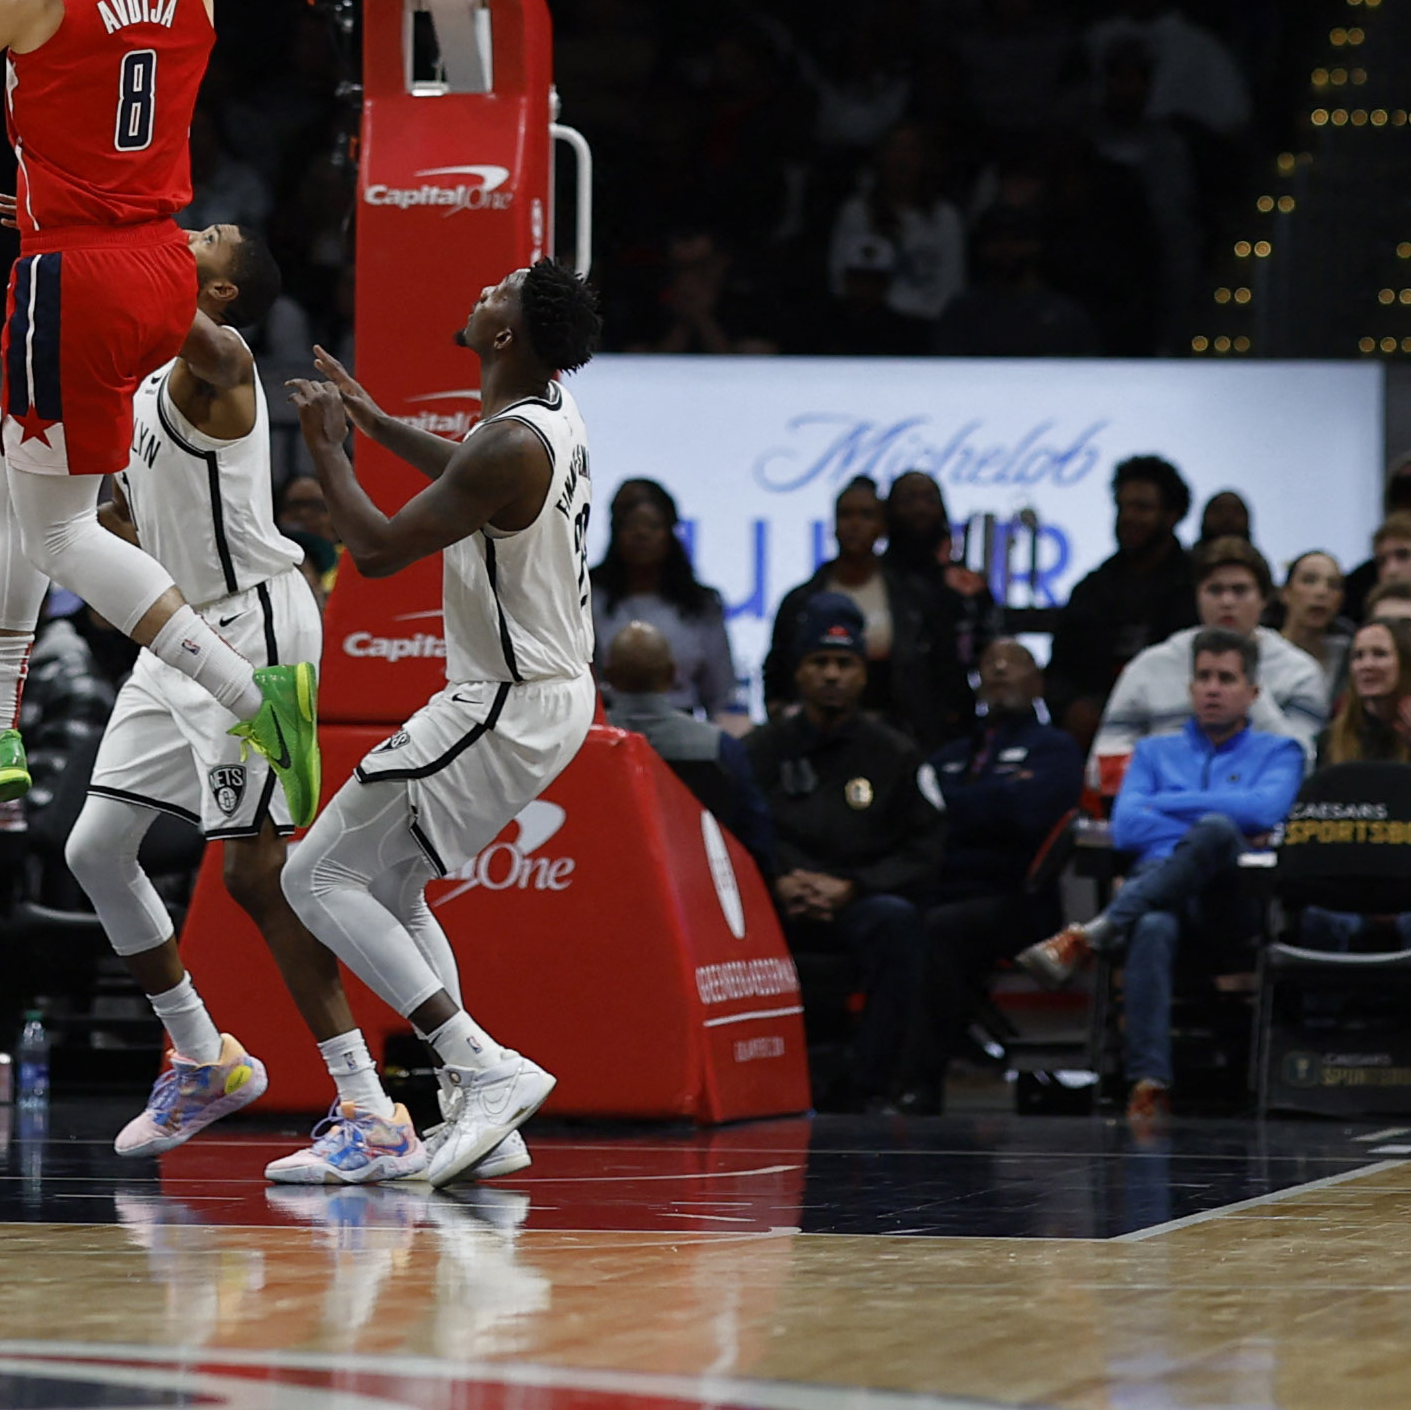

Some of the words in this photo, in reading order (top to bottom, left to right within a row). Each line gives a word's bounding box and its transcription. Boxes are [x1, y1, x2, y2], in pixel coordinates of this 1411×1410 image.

[114, 48, 157, 152] 8
[753, 412, 1108, 492] Michelob
[210, 767, 243, 790] NETS
[1289, 801, 1388, 821] CAESARS
